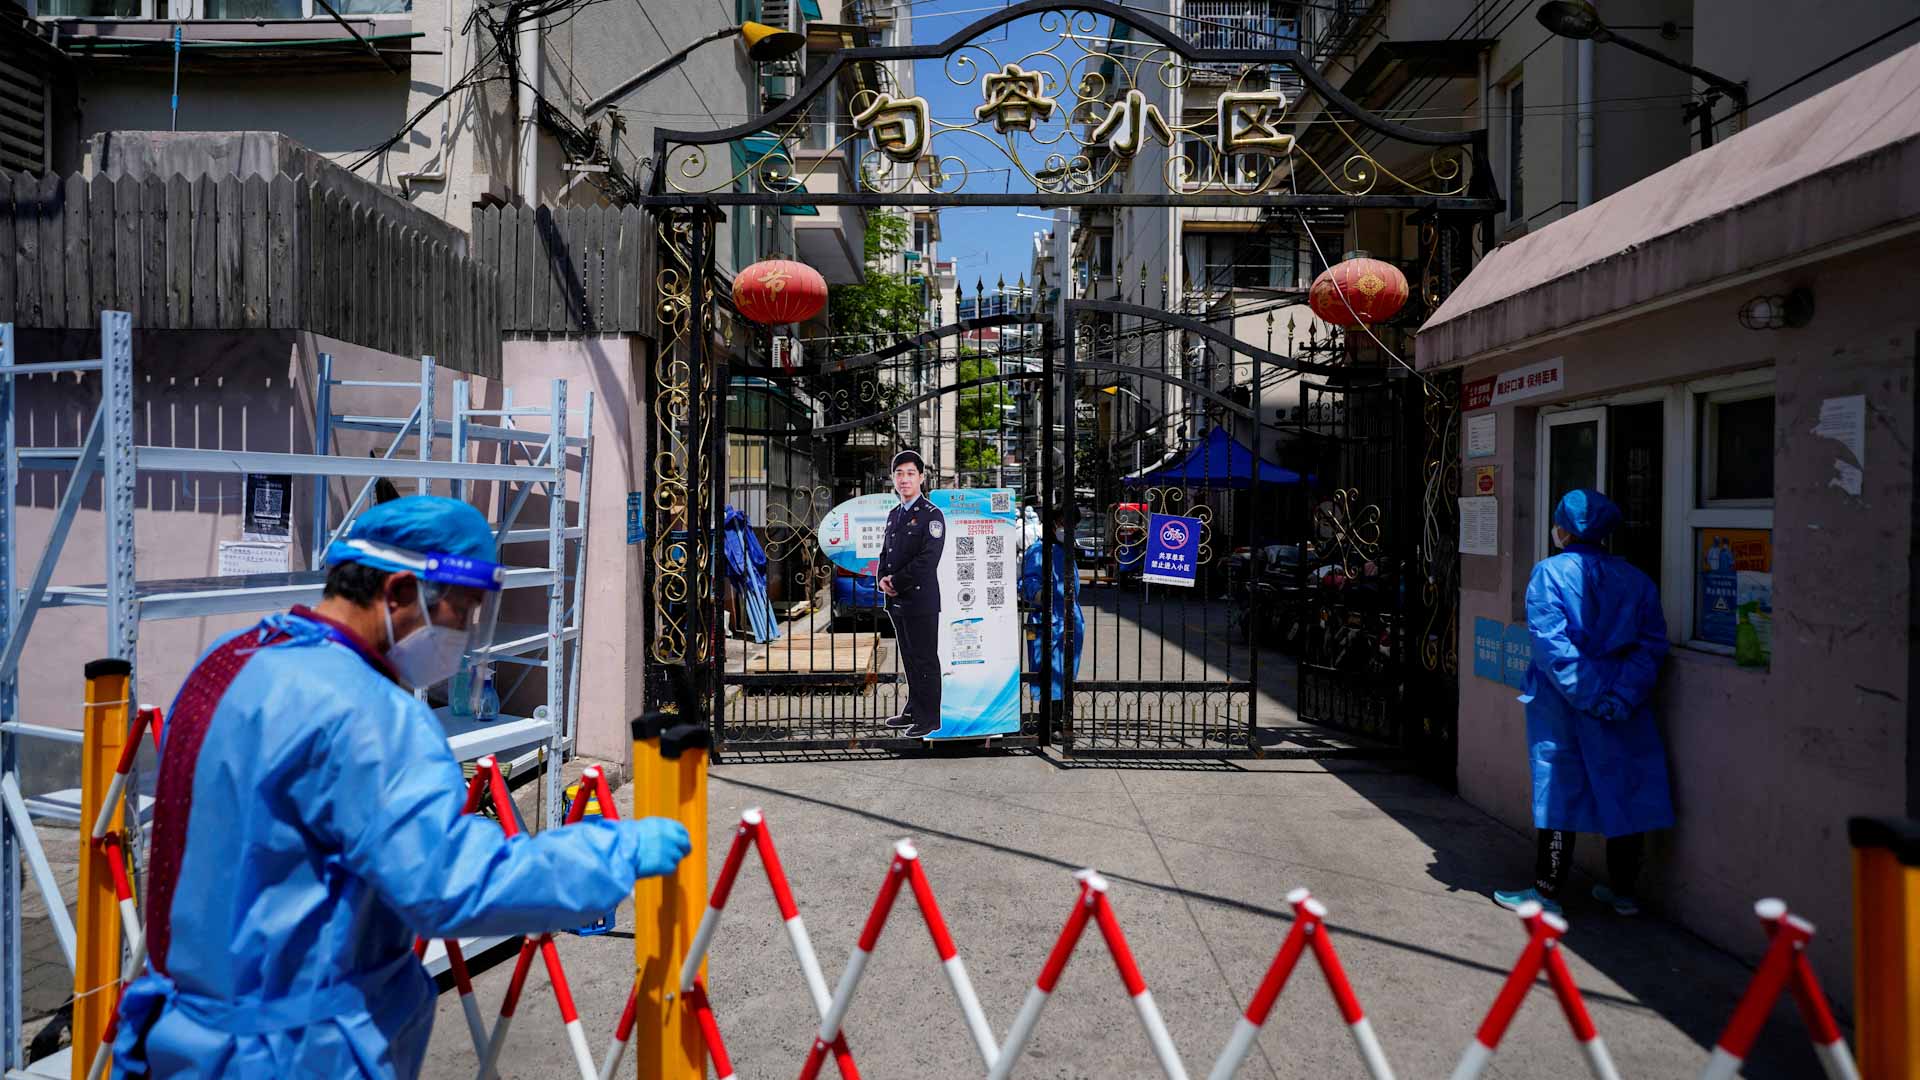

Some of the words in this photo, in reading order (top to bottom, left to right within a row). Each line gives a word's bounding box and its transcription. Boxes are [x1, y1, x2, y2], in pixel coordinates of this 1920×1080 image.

[853, 63, 1295, 163] 句容小区
[1527, 368, 1558, 386] 保持距离
[1158, 552, 1185, 562] 共享单车
[1151, 560, 1191, 572] 禁止进入小区
